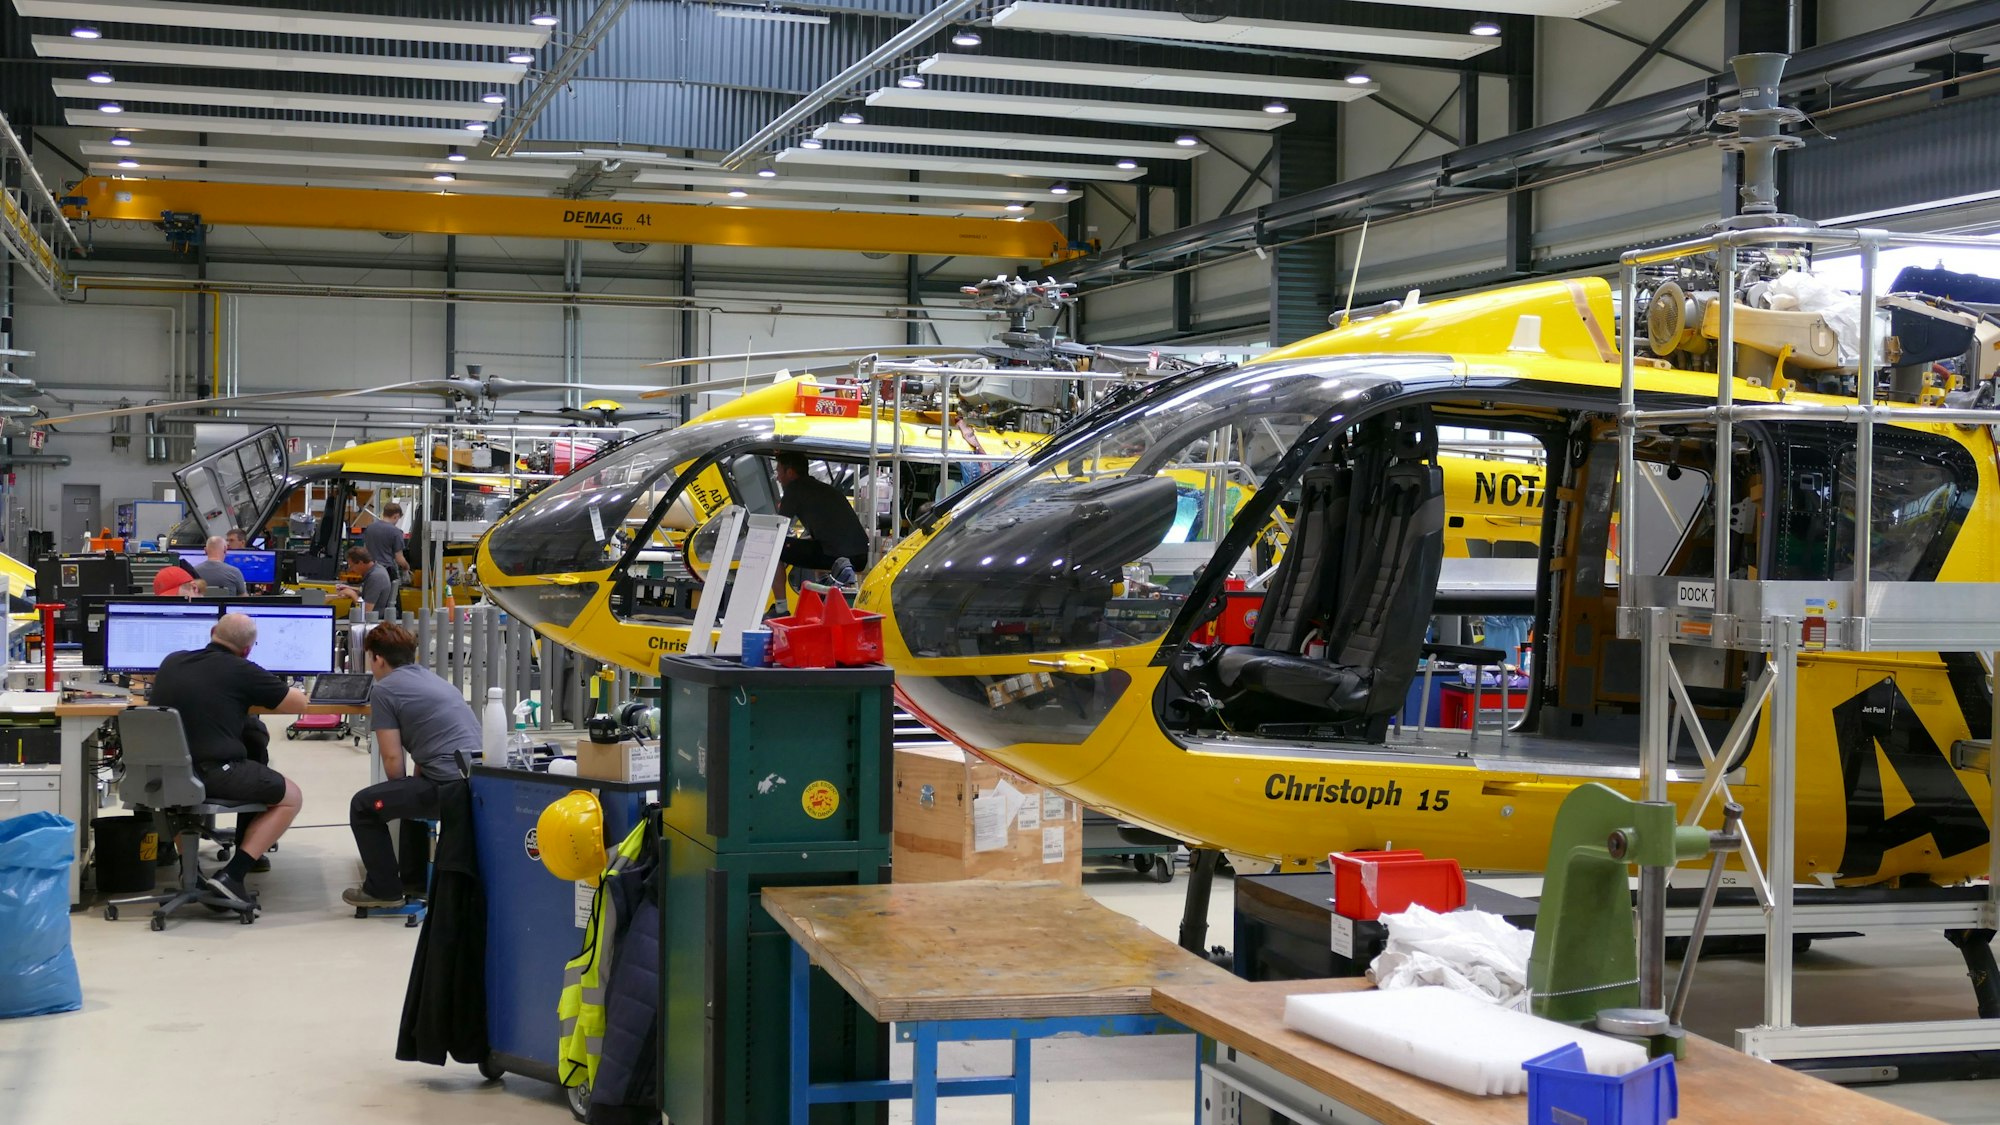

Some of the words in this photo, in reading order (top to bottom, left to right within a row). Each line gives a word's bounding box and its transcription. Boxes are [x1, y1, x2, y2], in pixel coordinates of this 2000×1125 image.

[563, 210, 623, 225] DEMAG
[636, 213, 652, 226] 4t
[1680, 586, 1708, 602] DOCK
[648, 636, 688, 652] Chris
[1873, 706, 1886, 714] Fuel
[1264, 773, 1403, 810] Christoph
[1416, 789, 1450, 812] 15
